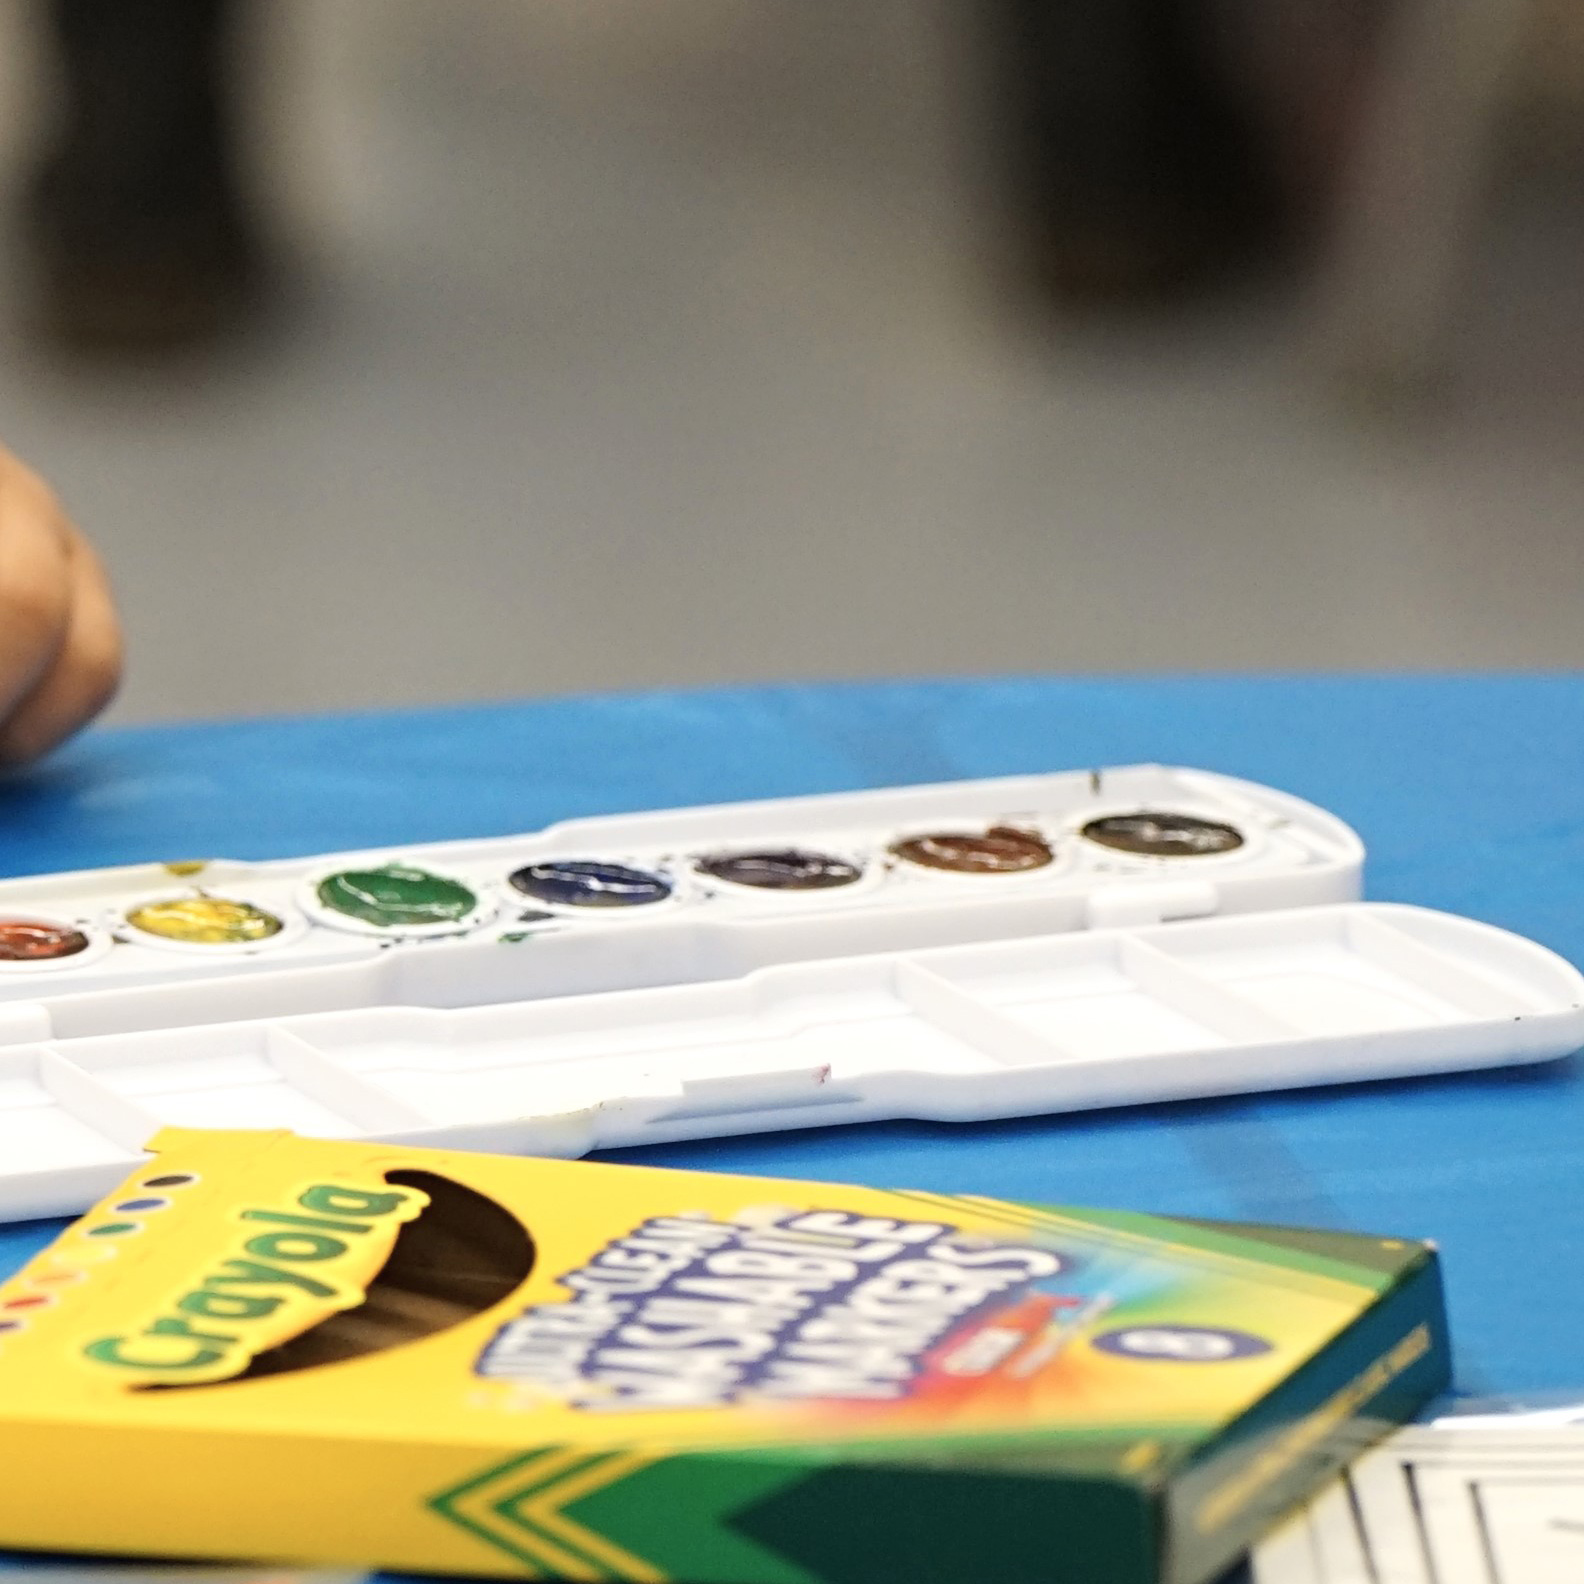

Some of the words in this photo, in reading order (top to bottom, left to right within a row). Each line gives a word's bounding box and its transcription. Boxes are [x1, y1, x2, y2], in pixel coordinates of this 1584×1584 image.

[83, 1184, 411, 1370] Crayola
[574, 1212, 946, 1406] WASHABLE
[742, 1243, 1062, 1399] MARKERS
